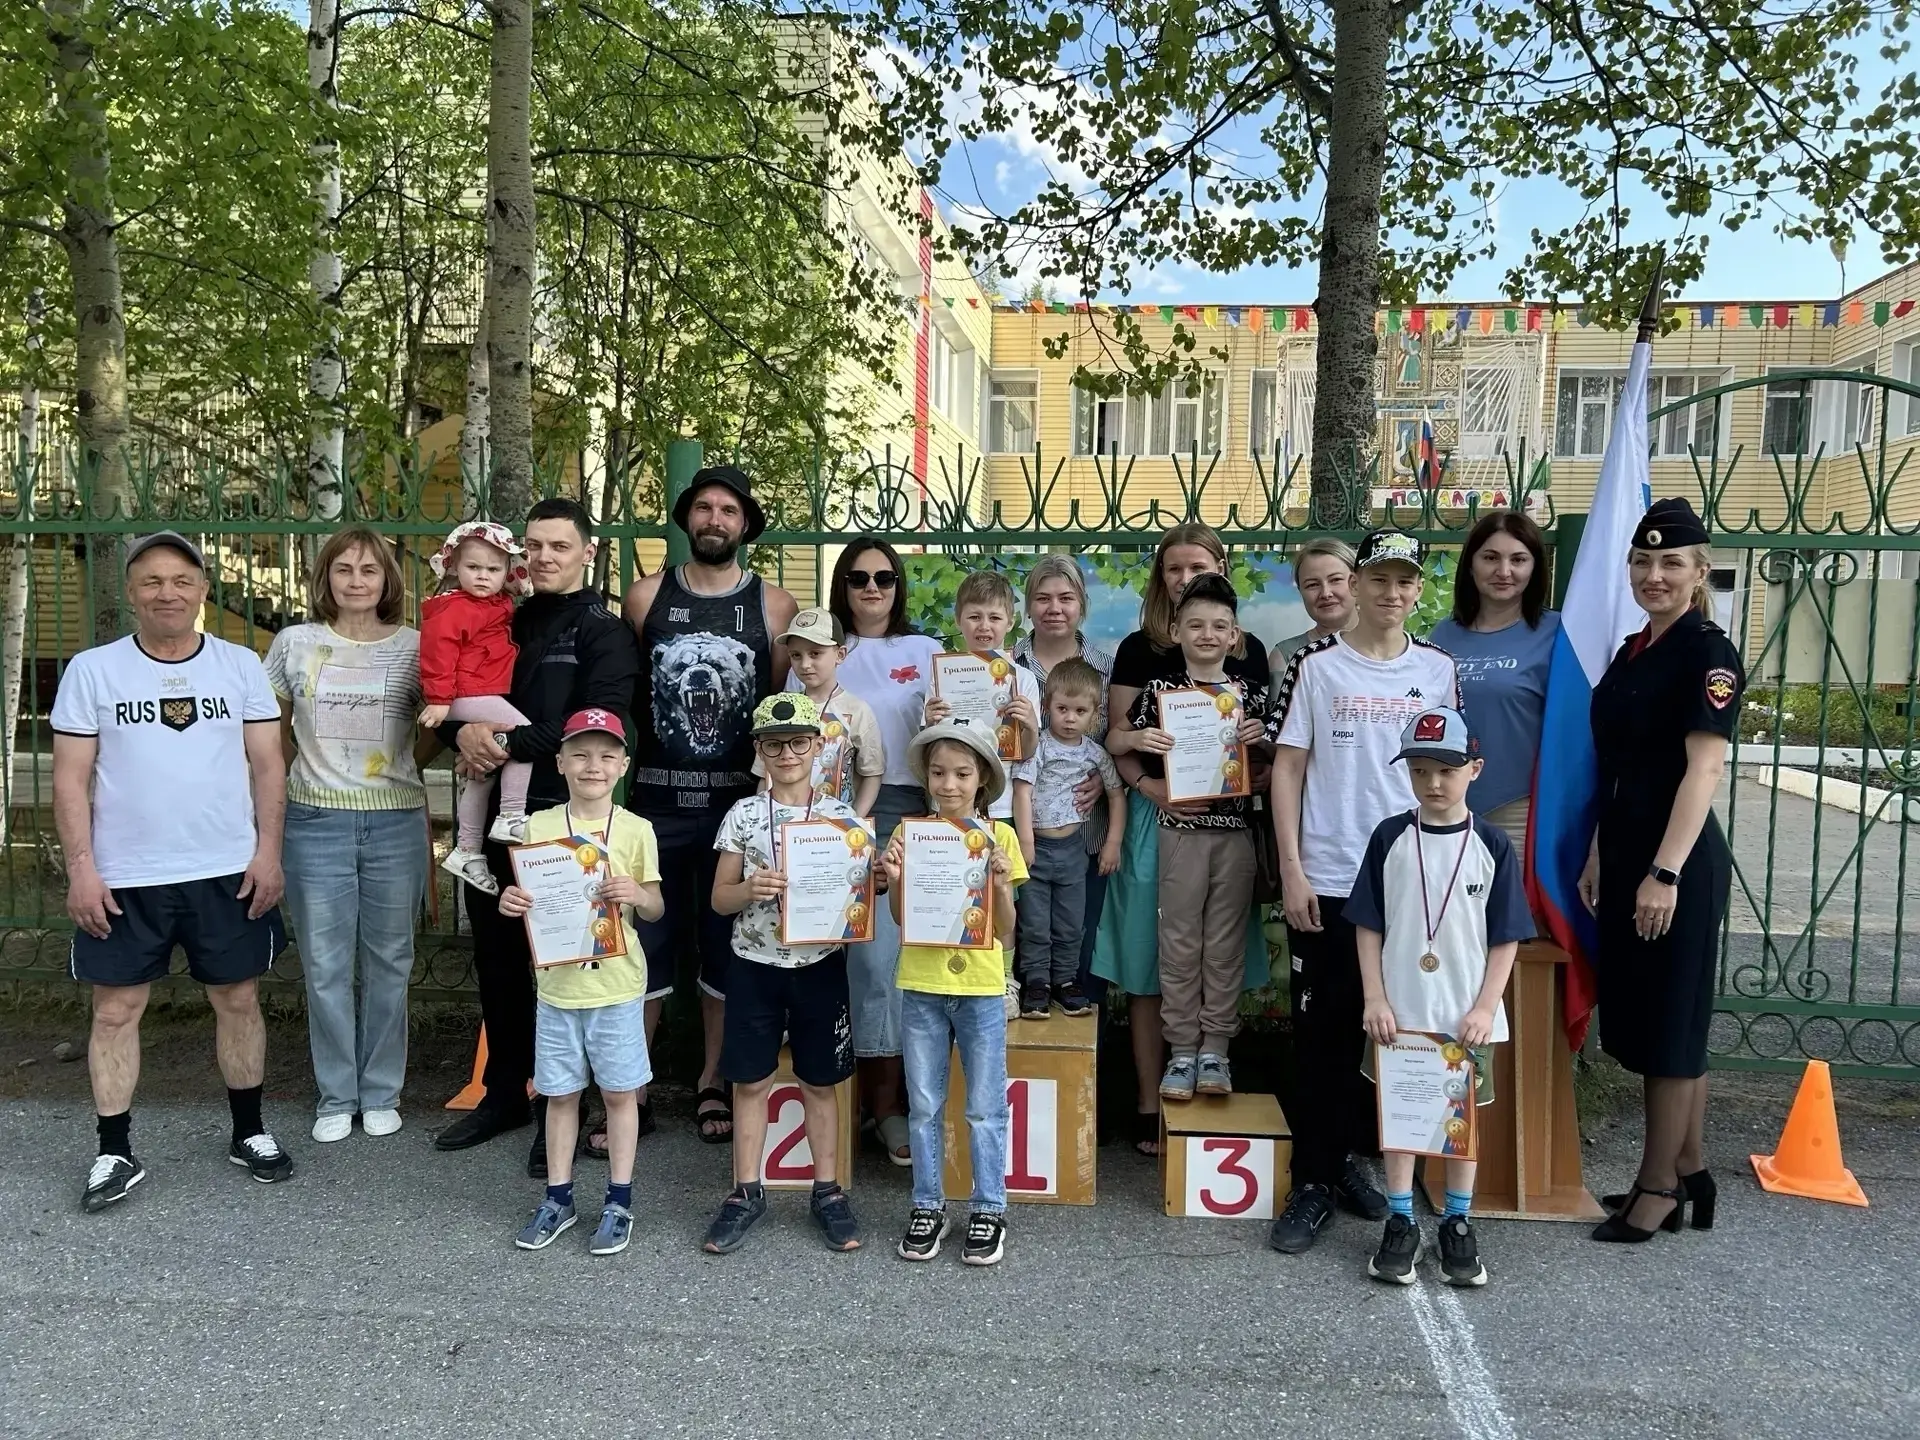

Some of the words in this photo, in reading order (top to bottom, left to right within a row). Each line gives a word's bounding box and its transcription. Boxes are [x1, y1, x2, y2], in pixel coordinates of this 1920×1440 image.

[1391, 490, 1533, 508] ПОАЛОВА
[734, 605, 744, 632] 1
[943, 665, 986, 676] Грамота
[1484, 659, 1518, 670] END
[326, 691, 375, 699] PERFECTLY
[115, 700, 156, 726] RUS
[201, 696, 231, 720] SIA
[318, 698, 381, 711] imperfect
[1168, 700, 1213, 711] Грамота
[1332, 730, 1354, 739] Kappa
[793, 835, 842, 846] Грамота
[912, 832, 960, 843] Грамота
[522, 854, 572, 869] Грамота
[765, 1086, 815, 1180] 2
[1004, 1080, 1047, 1191] 1
[1200, 1138, 1258, 1215] 3
